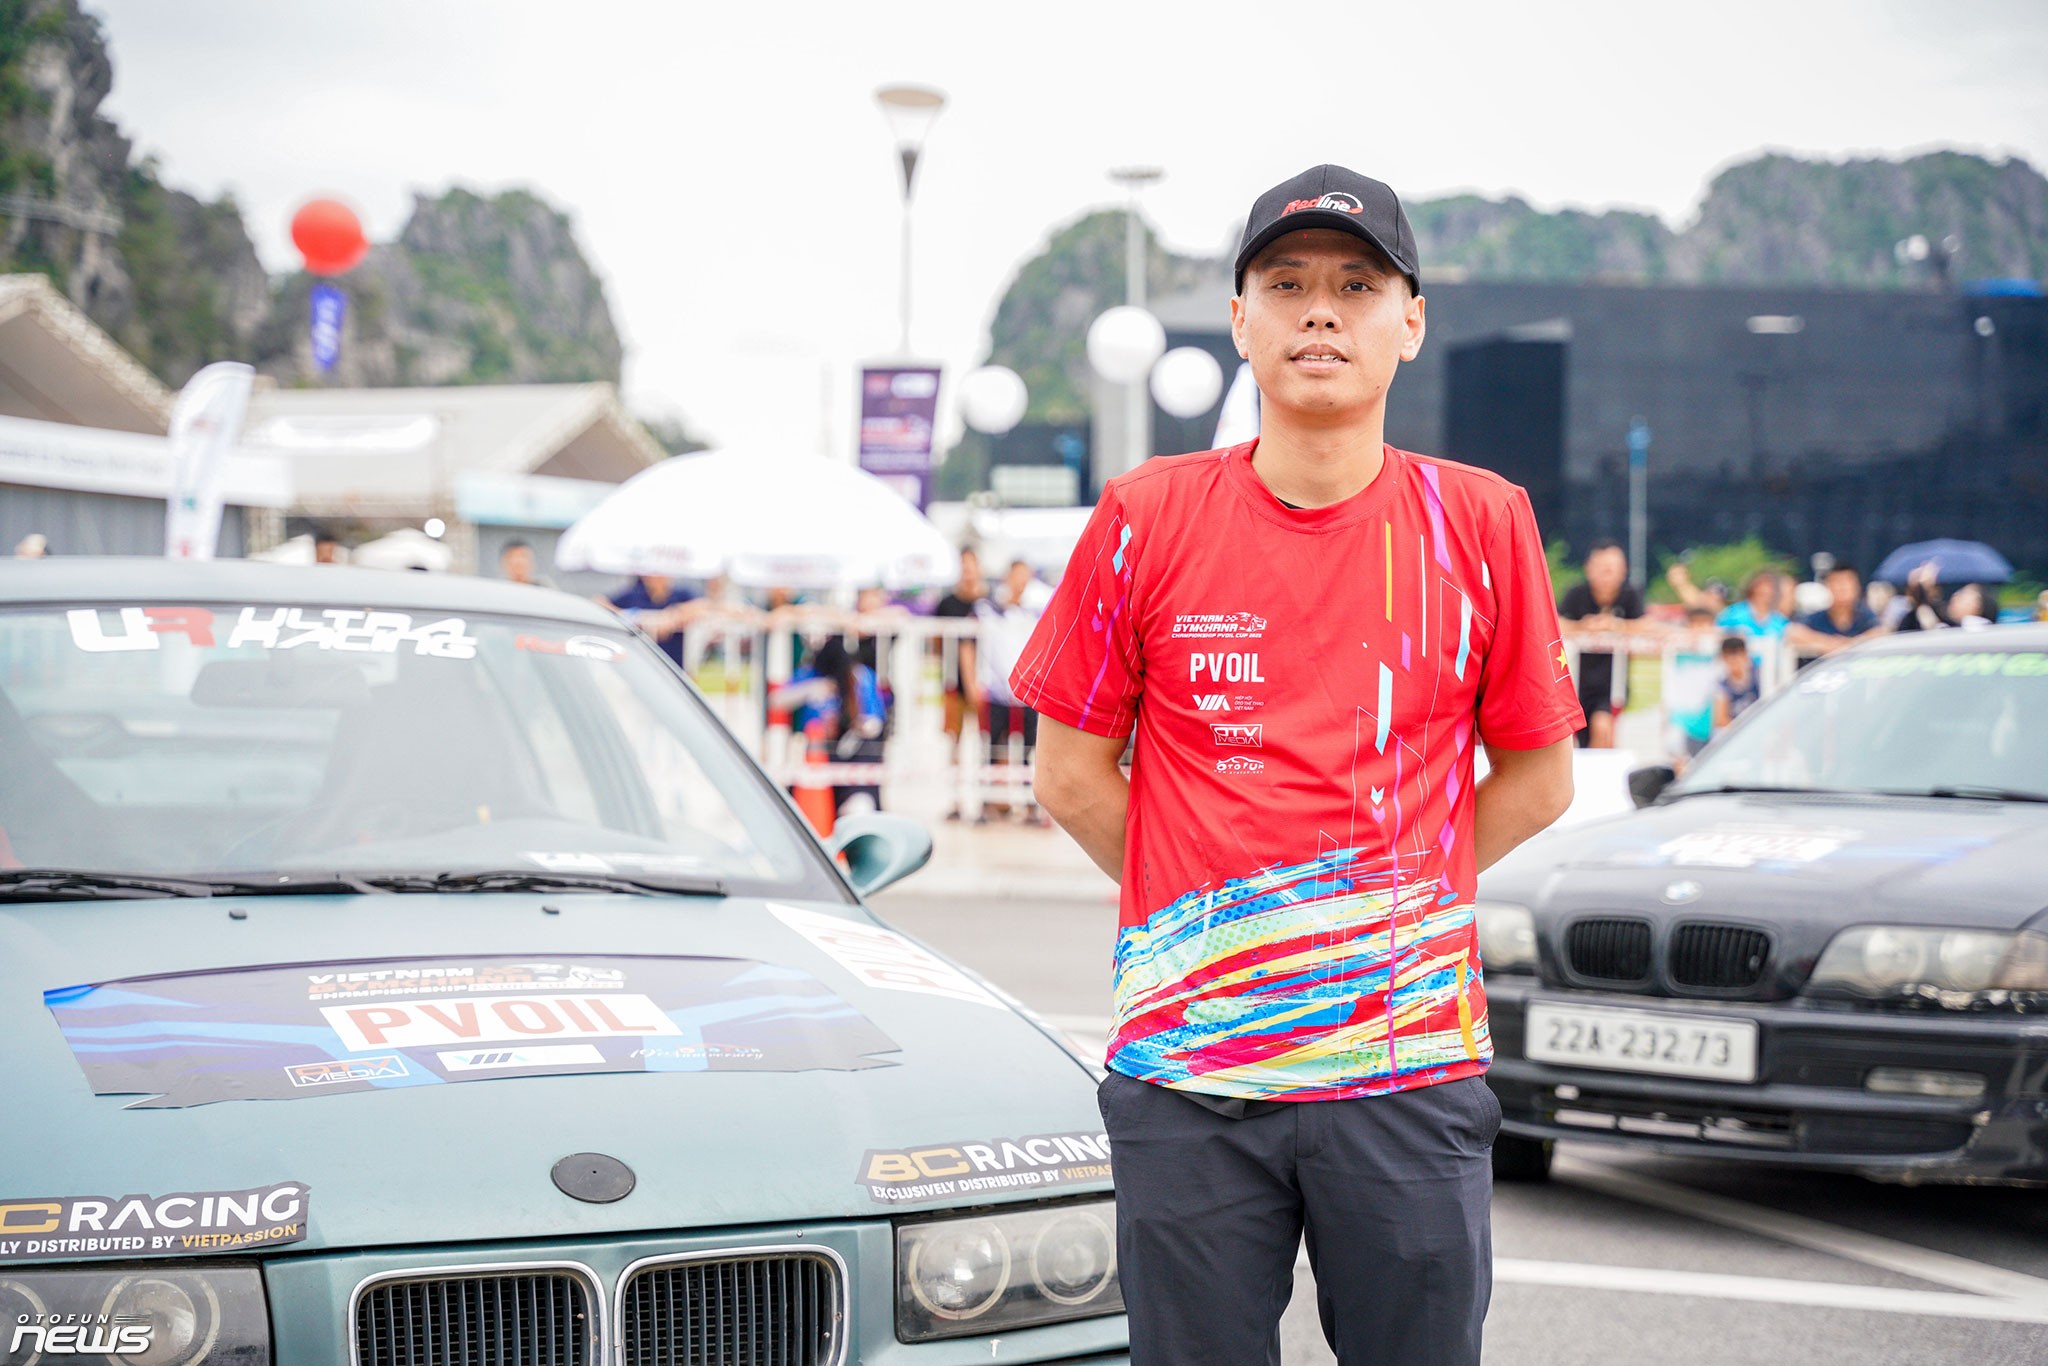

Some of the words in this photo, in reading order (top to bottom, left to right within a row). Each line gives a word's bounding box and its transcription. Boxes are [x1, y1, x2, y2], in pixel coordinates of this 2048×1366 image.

[1281, 195, 1350, 217] Redline
[1173, 623, 1239, 632] GYMKHANA
[1176, 615, 1224, 623] VIETNAM
[1190, 652, 1265, 683] PVOIL
[308, 967, 474, 984] VIETNAM
[345, 998, 658, 1045] PVOIL
[299, 1068, 402, 1083] MEDIA
[872, 1184, 956, 1200] EXCLUSIVELY
[960, 1172, 1042, 1192] DISTRIBUTED
[1045, 1169, 1061, 1183] BY
[68, 1187, 301, 1232] RACING
[26, 1235, 145, 1253] DISTRIBUTED
[151, 1235, 175, 1249] BY
[181, 1223, 298, 1248] VIETPASSION
